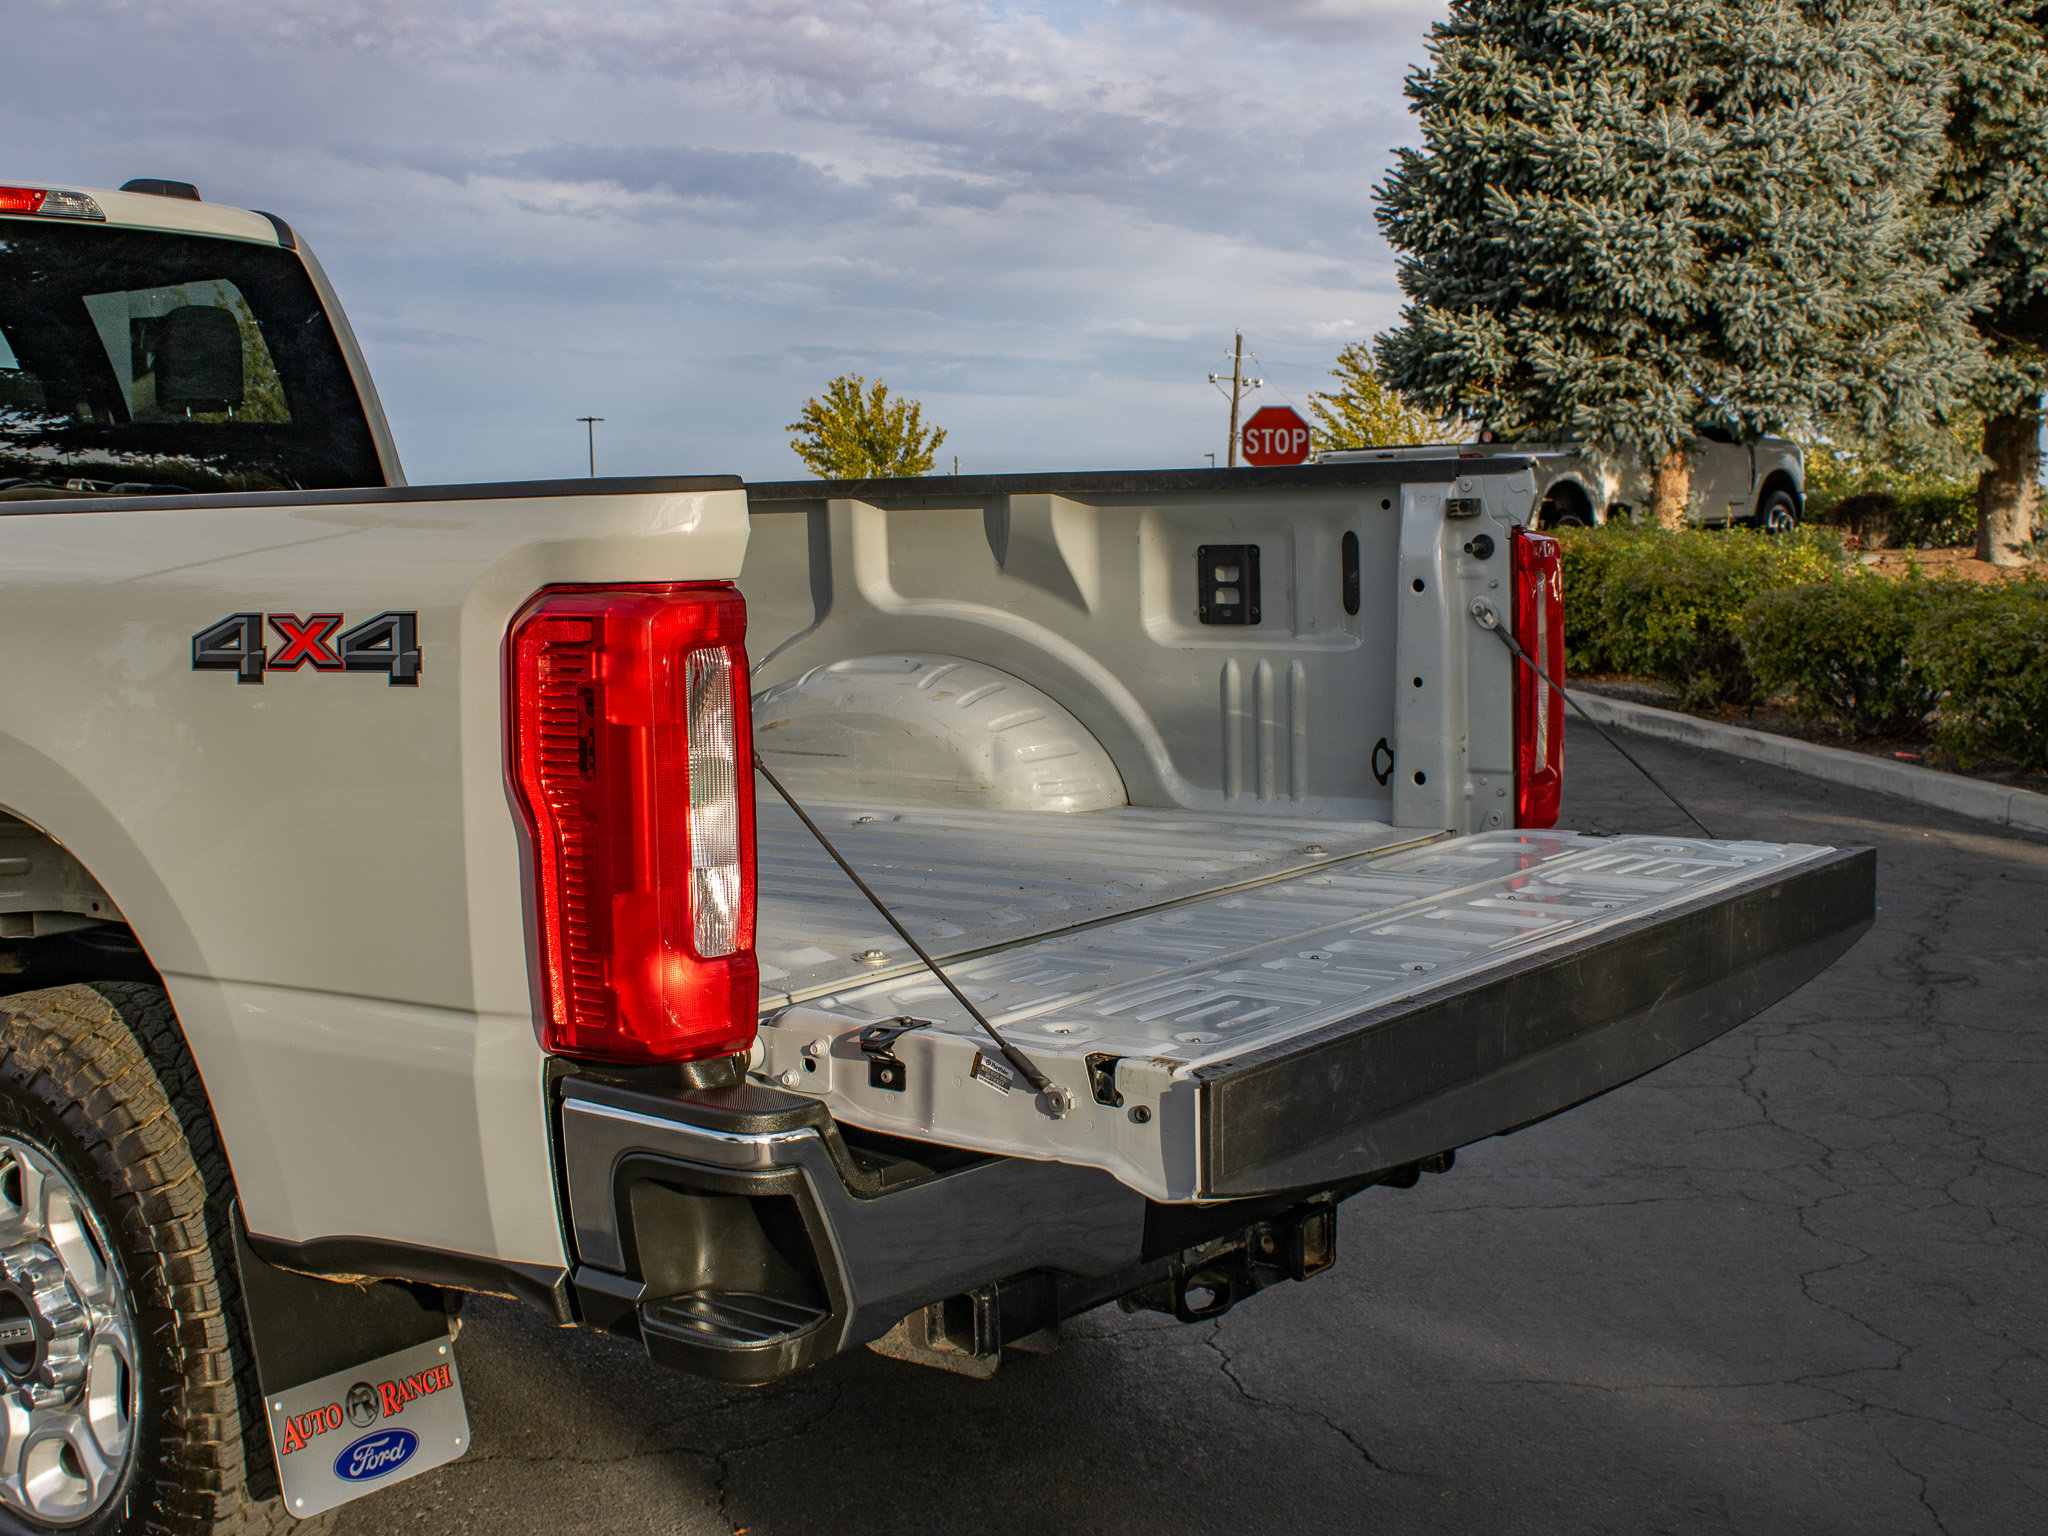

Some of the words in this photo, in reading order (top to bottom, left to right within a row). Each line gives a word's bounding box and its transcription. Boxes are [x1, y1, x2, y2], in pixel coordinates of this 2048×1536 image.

[1245, 428, 1307, 455] STOP
[192, 612, 423, 687] 4X4
[0, 1328, 28, 1338] ORD
[282, 1402, 344, 1455] AUTO
[376, 1363, 453, 1418] RANCH
[349, 1437, 407, 1477] Ford
